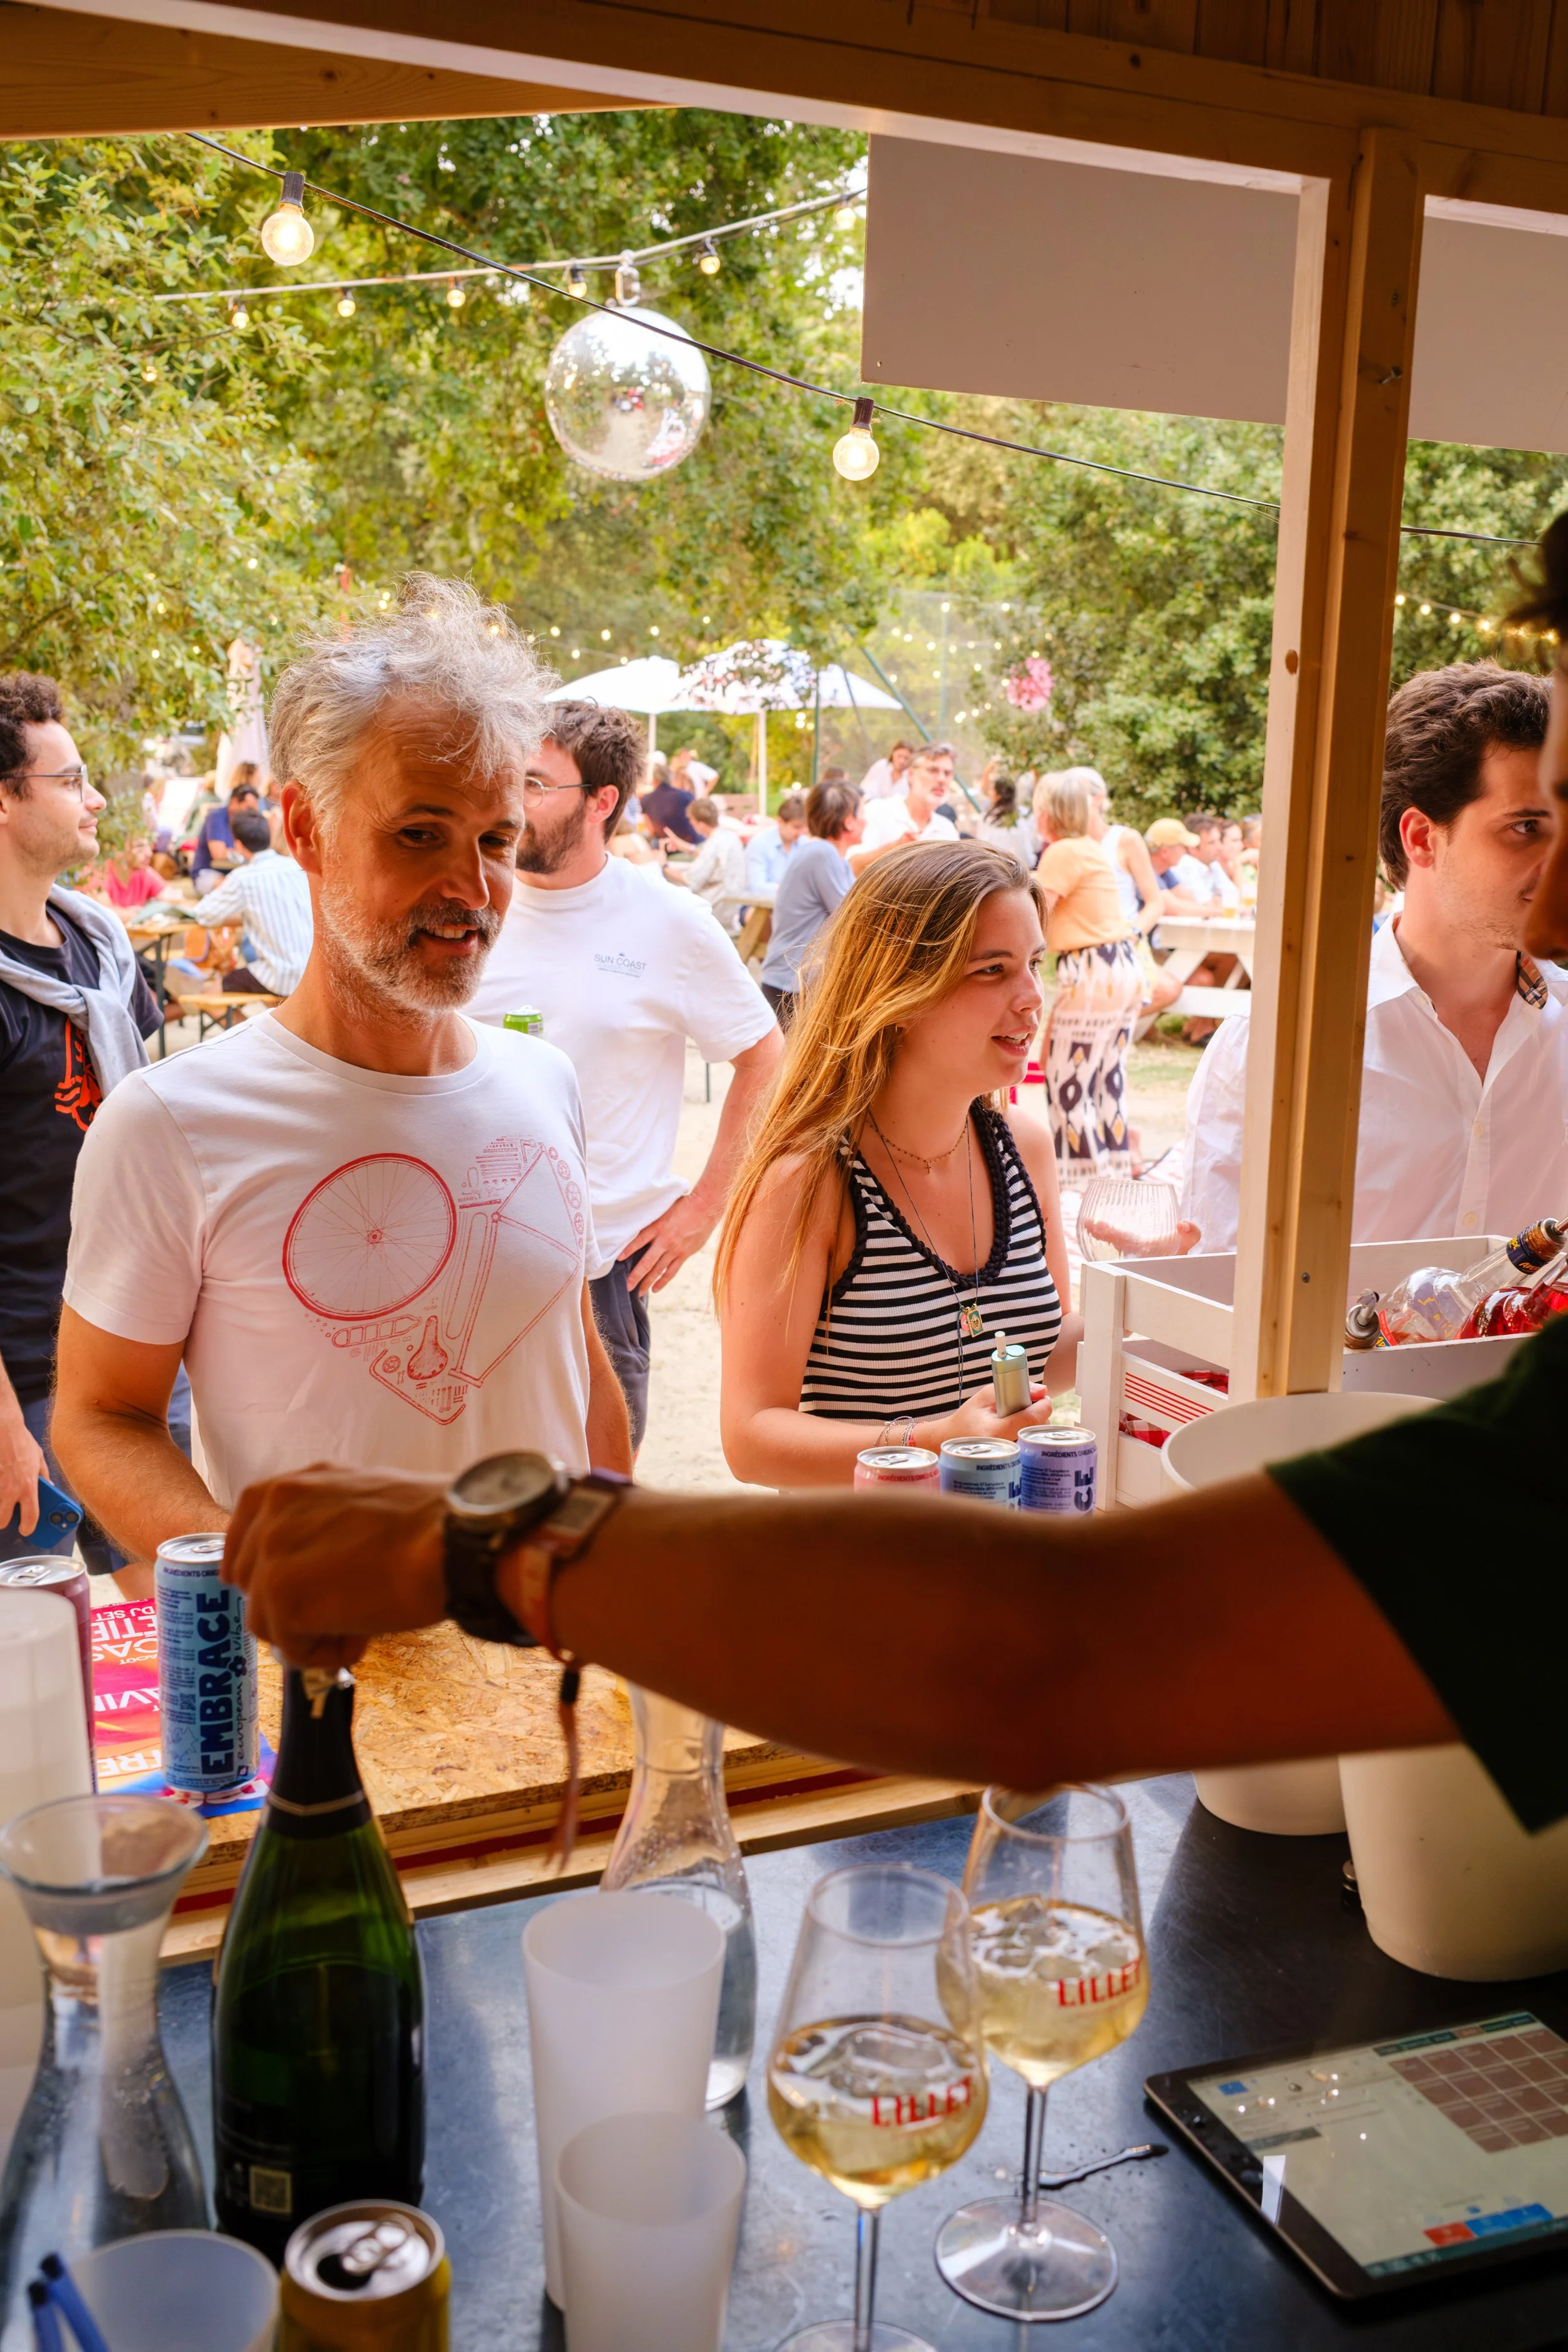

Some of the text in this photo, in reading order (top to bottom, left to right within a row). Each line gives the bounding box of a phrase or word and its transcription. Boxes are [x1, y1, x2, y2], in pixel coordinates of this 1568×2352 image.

[594, 953, 647, 970] SUN COAST
[95, 1606, 156, 1622] DJ SET
[196, 1589, 234, 1774] EMBRACE
[236, 1682, 247, 1760] european
[1058, 1957, 1140, 2006] LILLET
[871, 2074, 972, 2127] LILLET
